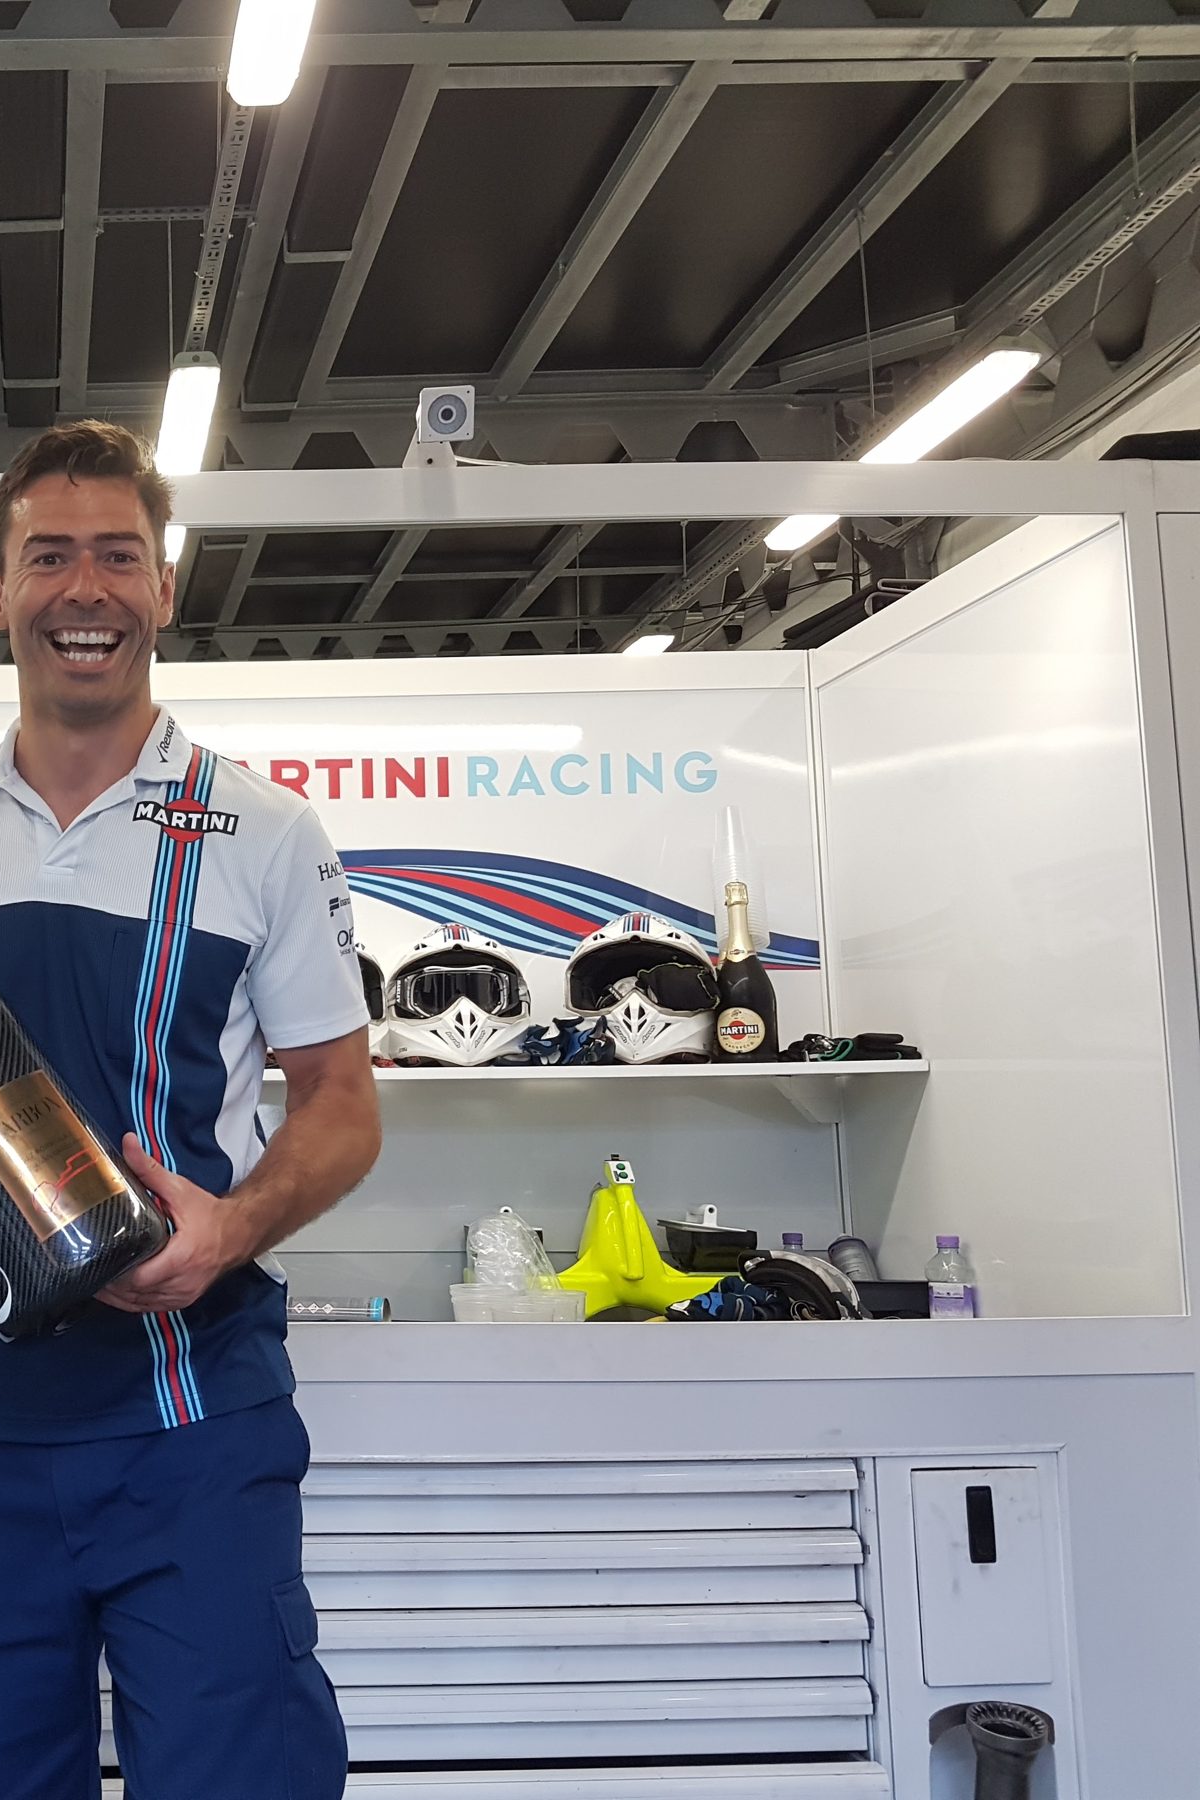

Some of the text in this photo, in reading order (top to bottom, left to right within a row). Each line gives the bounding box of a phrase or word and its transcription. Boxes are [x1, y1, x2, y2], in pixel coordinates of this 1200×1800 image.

[467, 751, 718, 797] RACING
[136, 803, 236, 833] MARTINI
[720, 1025, 758, 1035] MARTINI
